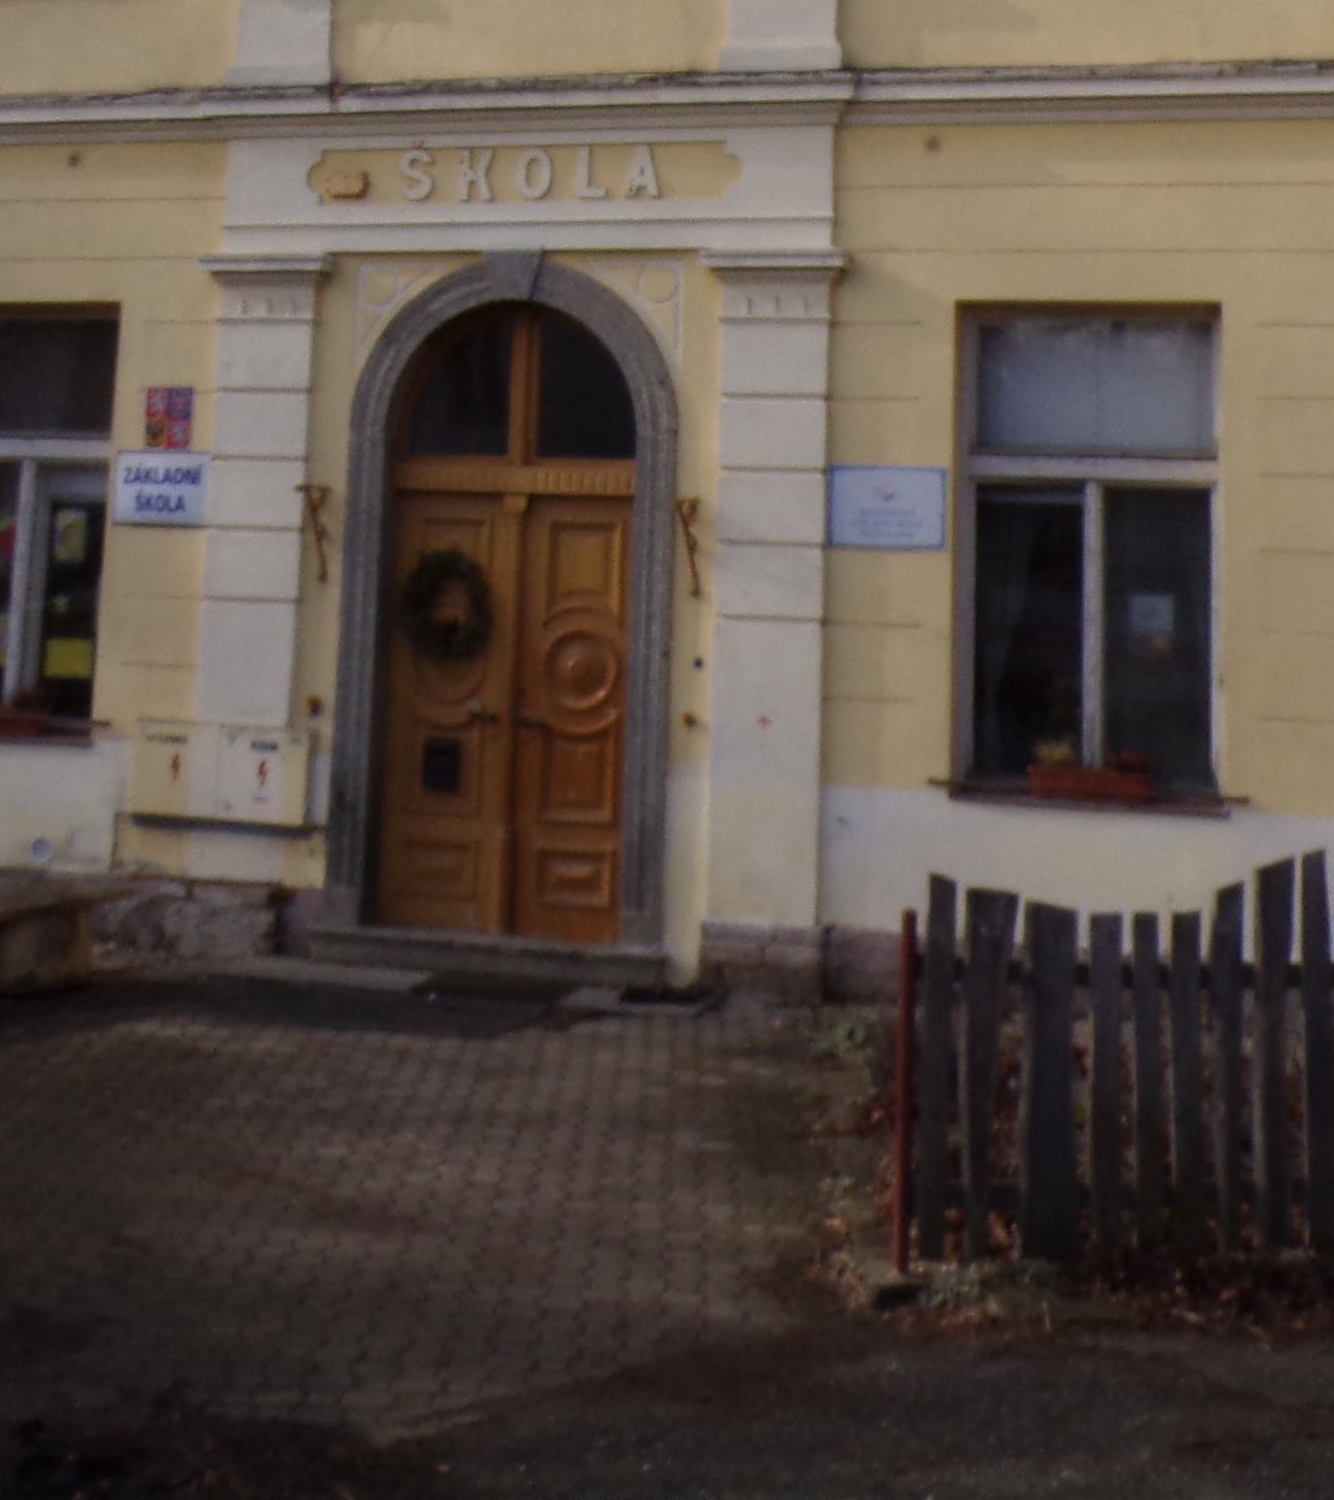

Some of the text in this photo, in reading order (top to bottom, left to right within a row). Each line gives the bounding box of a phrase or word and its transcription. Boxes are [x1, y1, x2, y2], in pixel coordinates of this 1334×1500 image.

[399, 140, 661, 202] ŠKOLA
[123, 461, 203, 486] ZÁKLADNÍ
[135, 489, 187, 514] ŠKOLA
